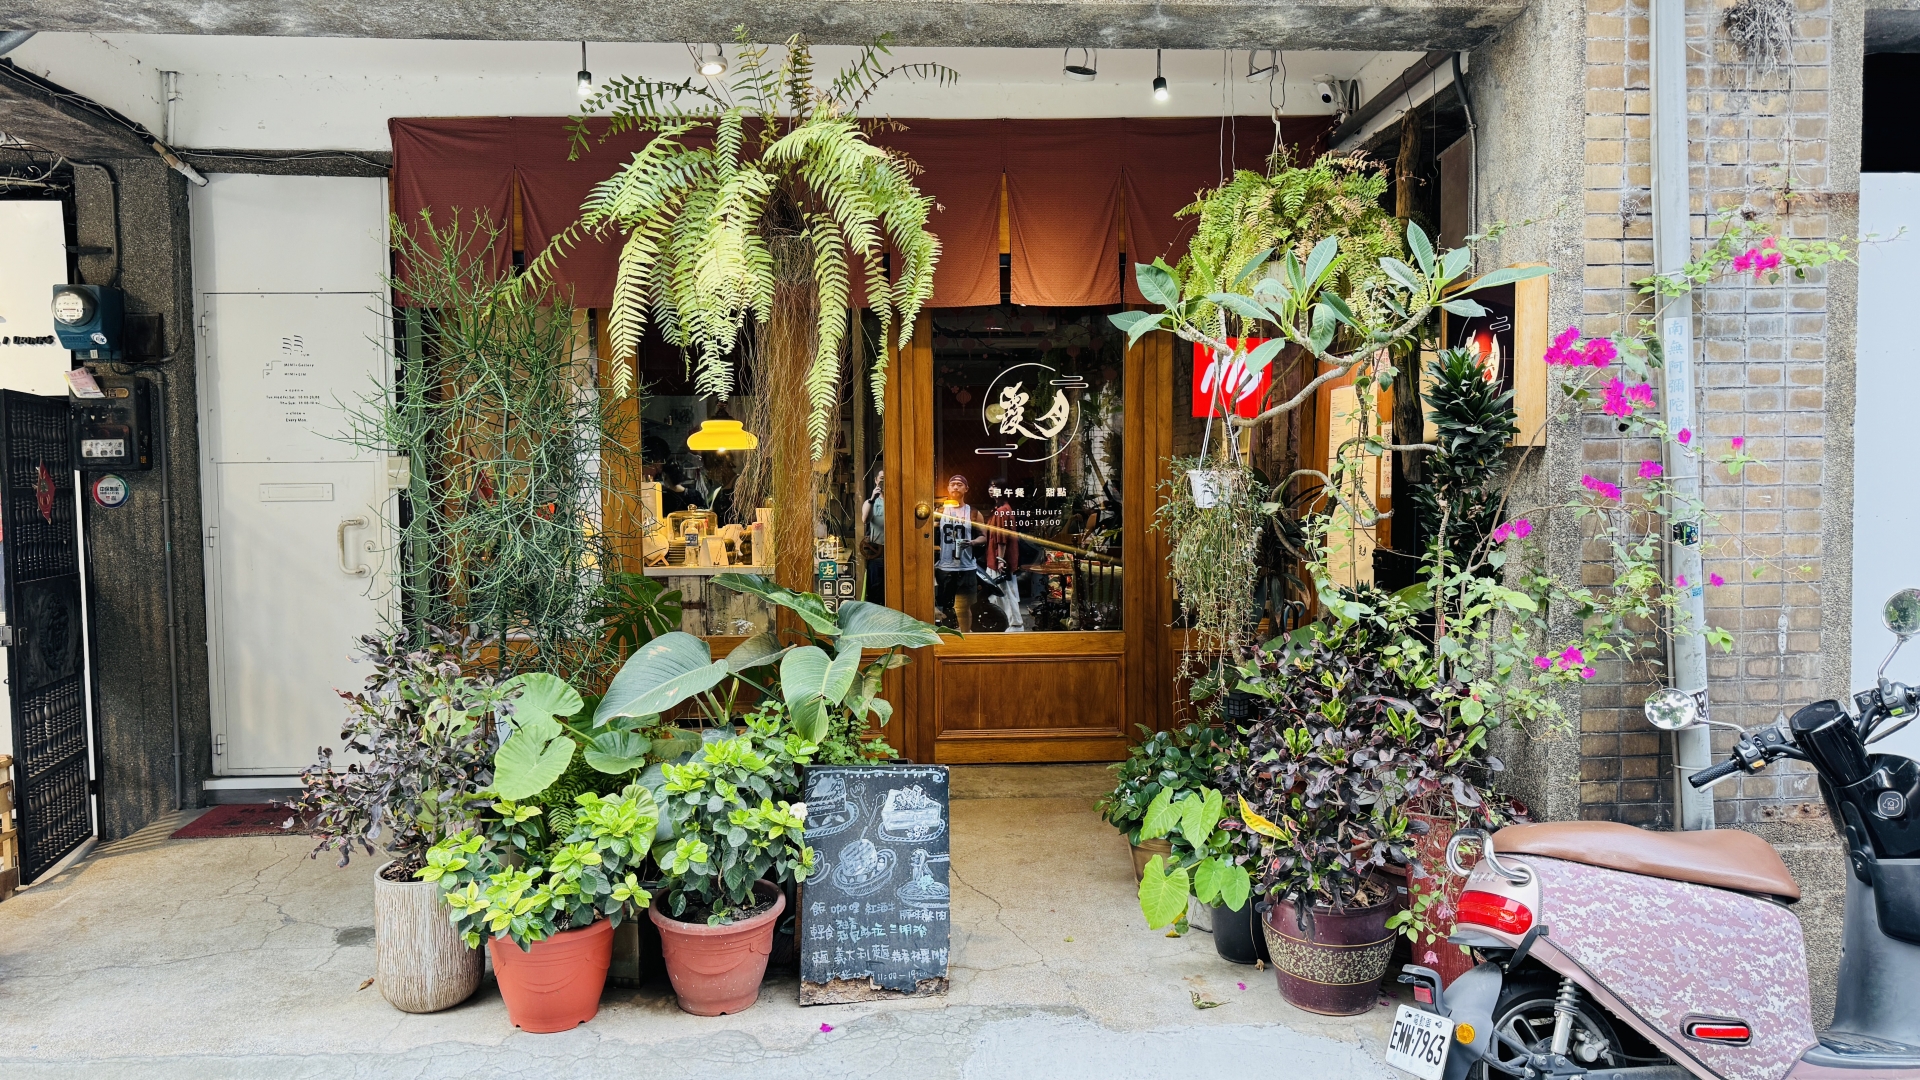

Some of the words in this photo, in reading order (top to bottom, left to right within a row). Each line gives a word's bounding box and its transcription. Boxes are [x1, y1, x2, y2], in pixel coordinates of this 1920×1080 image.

[993, 487, 1025, 498] 早午餐
[1045, 487, 1067, 497] 甜點
[994, 508, 1031, 517] opening
[1035, 508, 1062, 516] Hours
[1003, 519, 1061, 527] 11:00-19:00
[810, 901, 827, 916] 飯
[831, 902, 861, 915] 咖哩
[810, 924, 835, 941] 輕食
[889, 923, 928, 938] 三明治
[834, 944, 890, 965] 義大利麵
